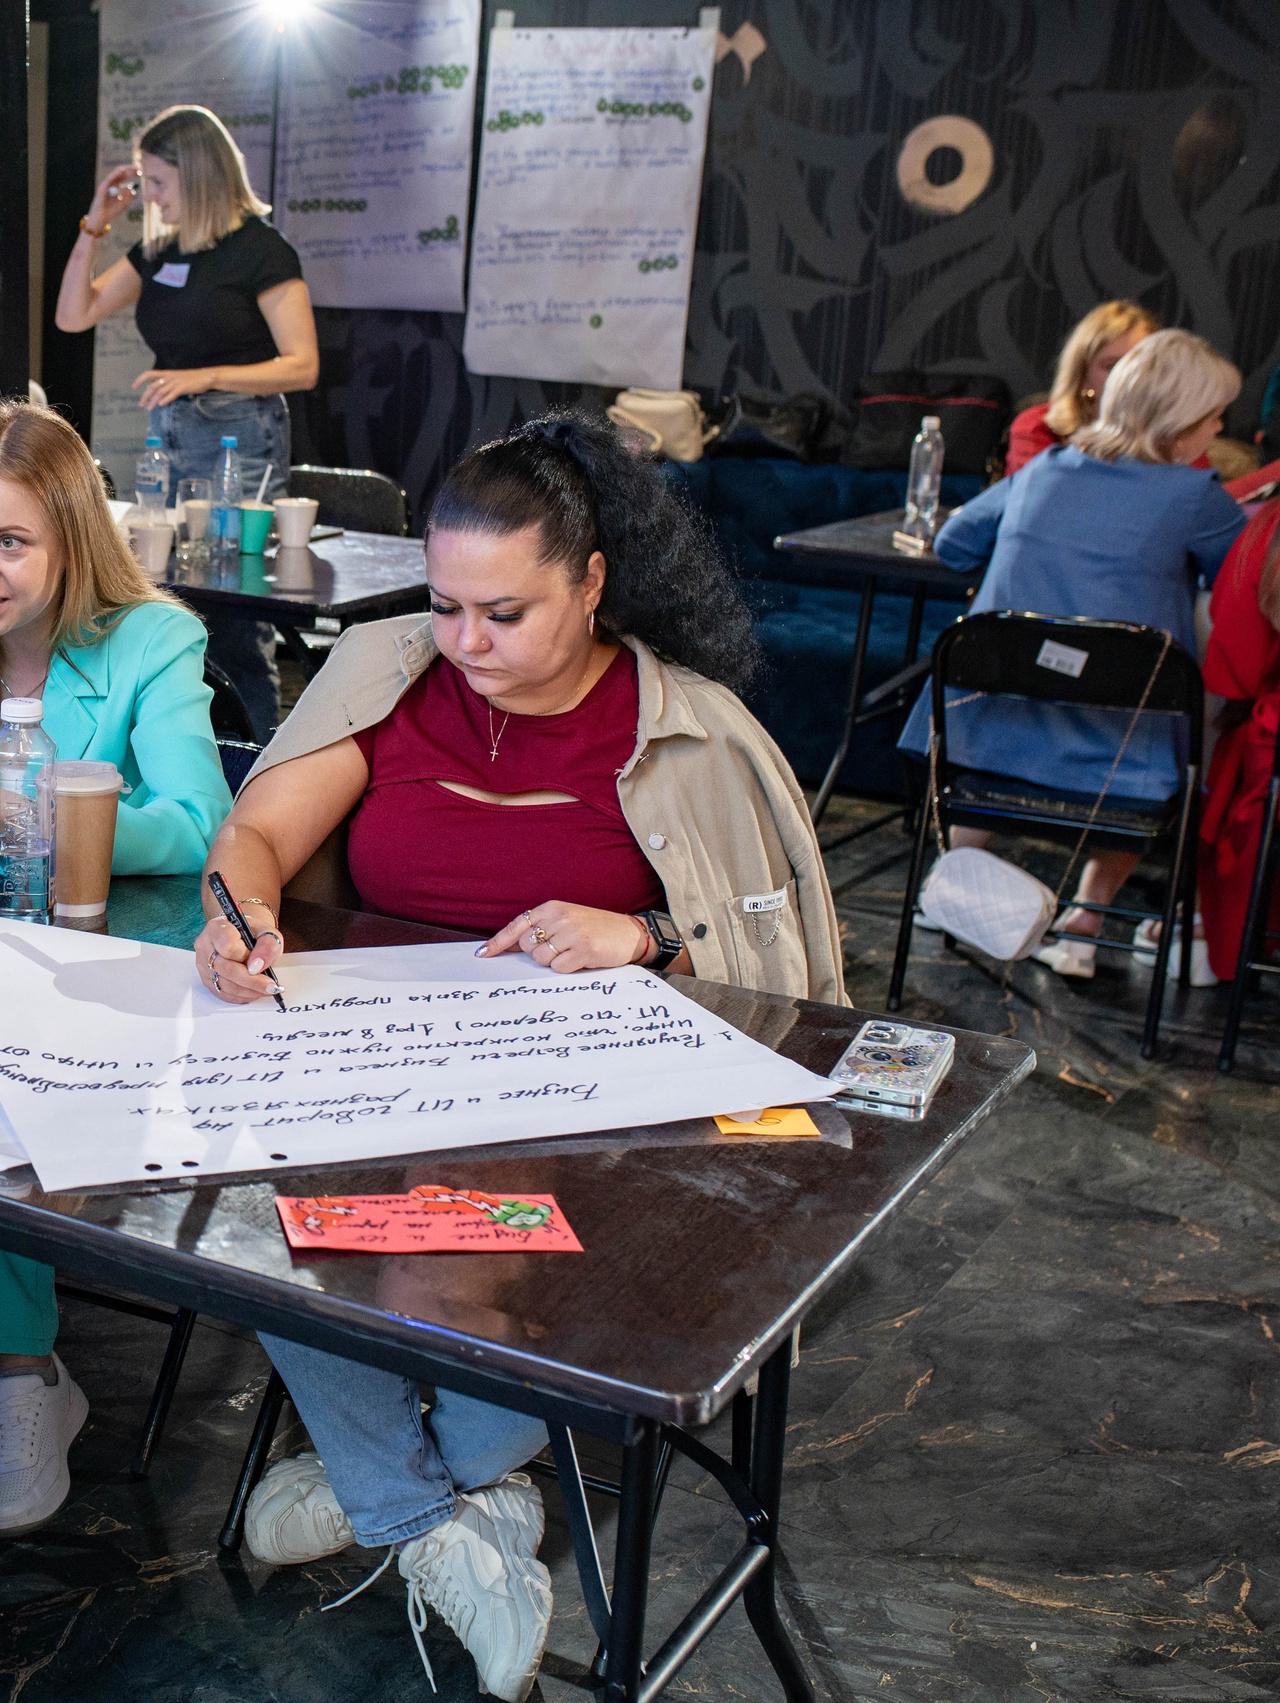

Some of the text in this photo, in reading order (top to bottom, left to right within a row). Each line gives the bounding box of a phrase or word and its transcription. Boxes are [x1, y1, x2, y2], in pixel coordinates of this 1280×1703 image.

[489, 981, 616, 998] Адаптация
[581, 1011, 622, 1020] что
[306, 1043, 392, 1055] нужно
[404, 1034, 551, 1052] конкретно
[578, 1030, 705, 1052] Регулярные
[41, 1053, 118, 1069] инфо
[168, 1051, 291, 1064] Бизнесу
[339, 1057, 450, 1072] Бизнеса
[295, 1088, 411, 1106] разных
[499, 1083, 599, 1102] Бизнес
[410, 1099, 454, 1112] ИТ
[250, 1104, 391, 1127] говорит
[192, 1120, 233, 1131] на
